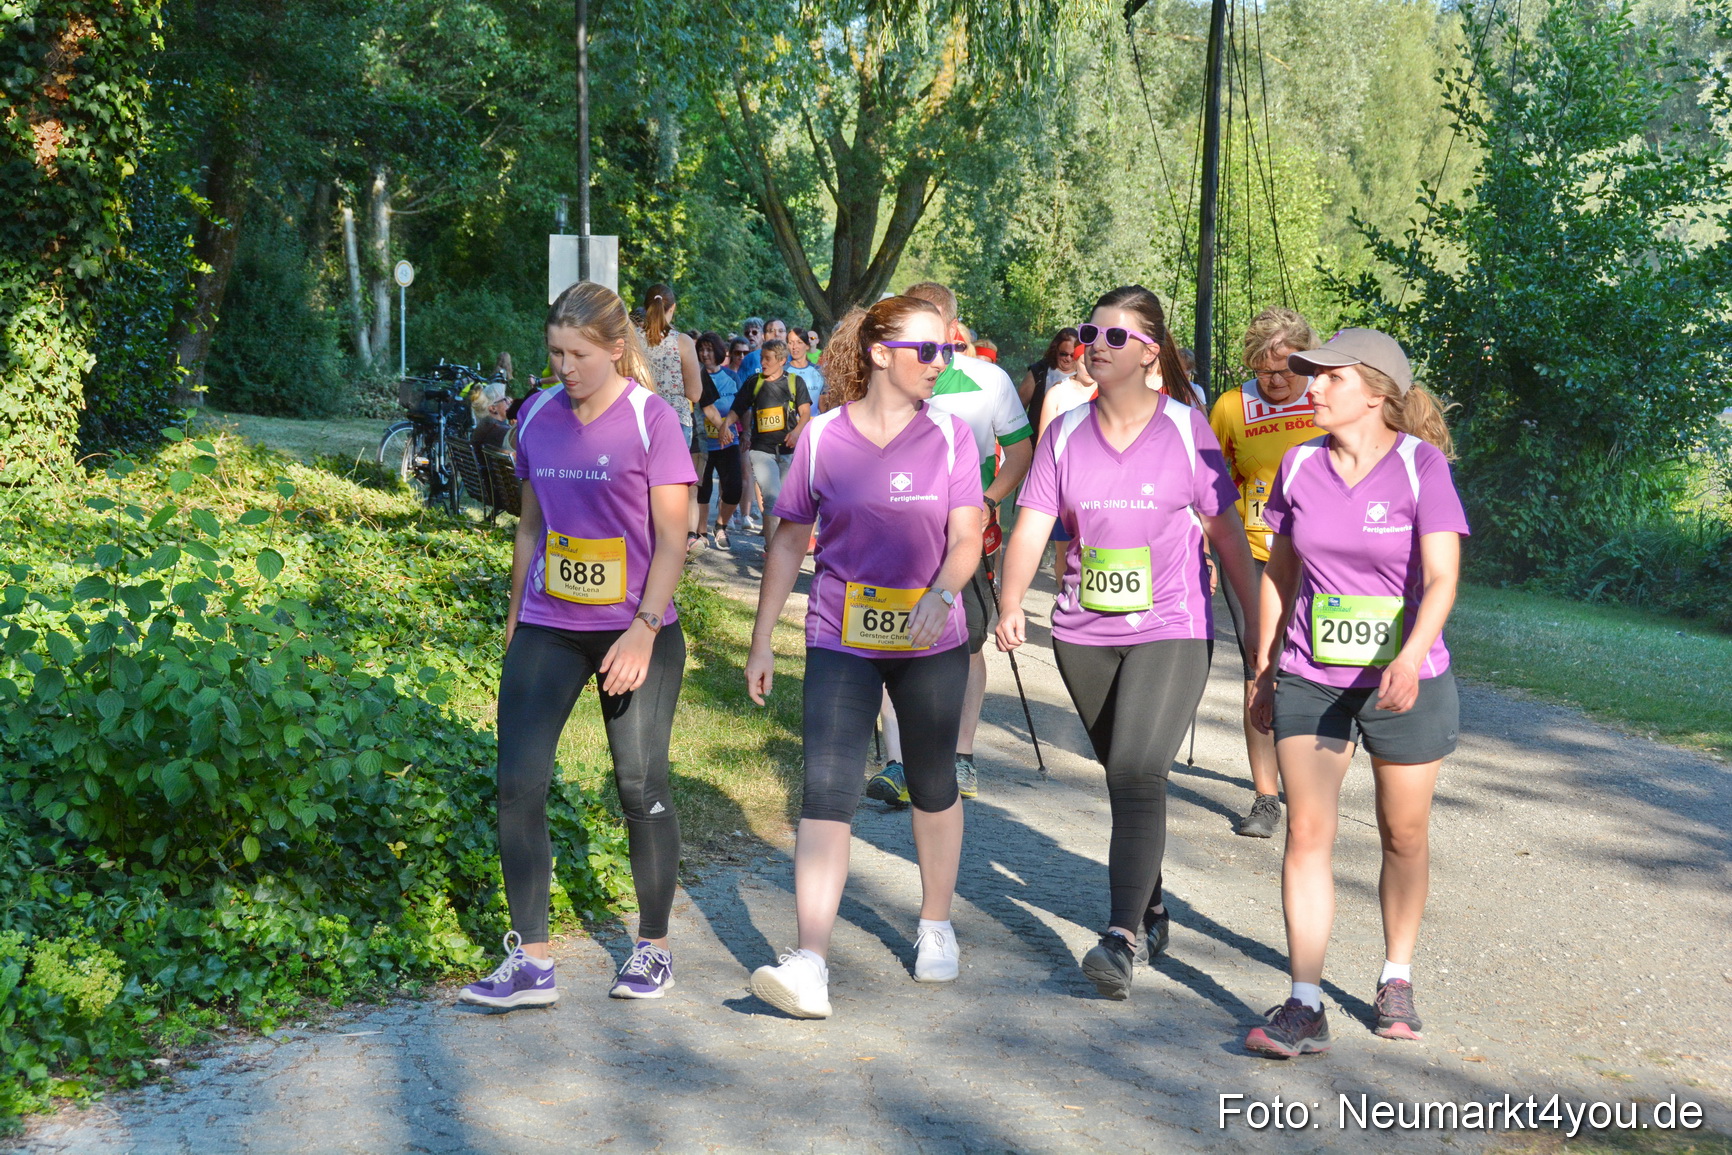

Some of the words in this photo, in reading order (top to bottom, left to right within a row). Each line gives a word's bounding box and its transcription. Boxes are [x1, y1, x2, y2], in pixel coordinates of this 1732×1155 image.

[759, 415, 781, 426] 1708
[1244, 422, 1281, 438] MAX
[536, 468, 555, 478] WIR
[558, 469, 583, 479] SIND
[585, 471, 612, 481] LILA.
[890, 494, 938, 503] Fertigteilwerke
[1080, 500, 1101, 510] WIR
[1103, 499, 1128, 509] SIND
[1130, 500, 1158, 510] LILA.
[559, 558, 606, 586] 688
[564, 583, 580, 591] Hofer
[1085, 568, 1141, 594] 2096
[862, 608, 910, 634] 687
[859, 631, 889, 640] Gerstner
[1320, 619, 1390, 646] 2098
